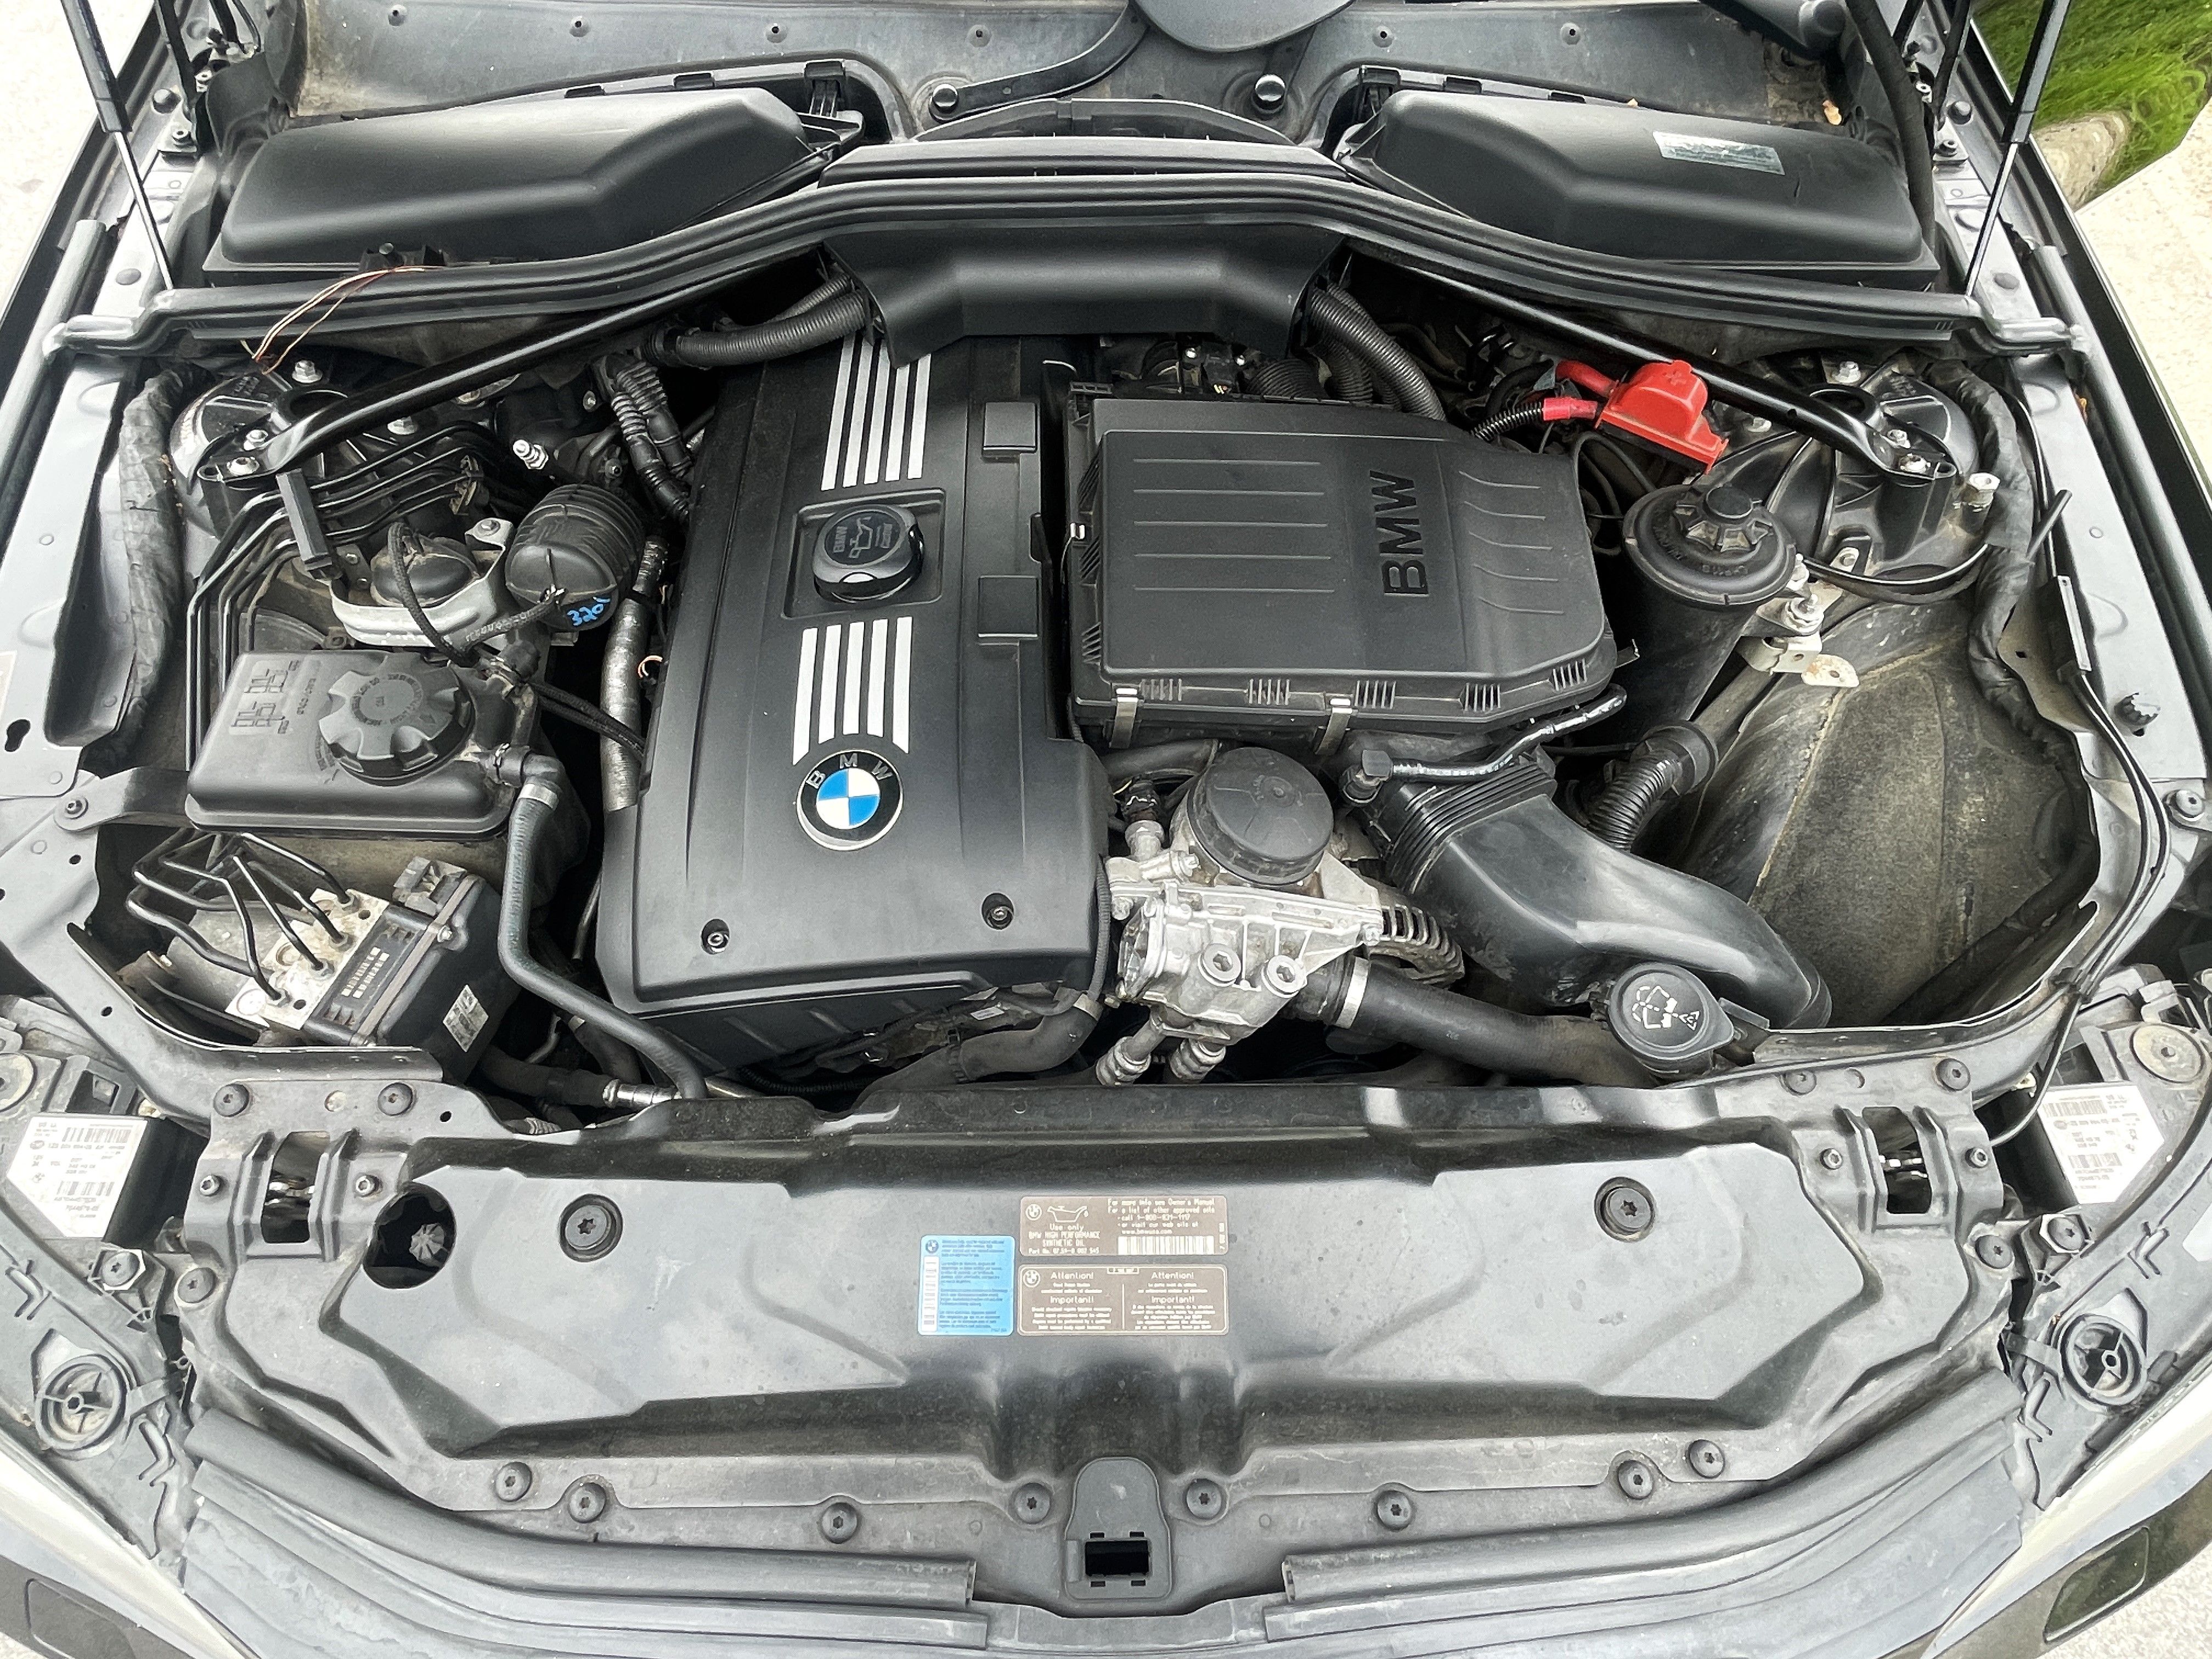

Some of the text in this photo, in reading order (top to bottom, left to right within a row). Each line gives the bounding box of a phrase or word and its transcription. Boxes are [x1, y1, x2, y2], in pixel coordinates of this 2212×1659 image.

[833, 526, 848, 554] BMW
[1369, 470, 1429, 596] BMW
[805, 753, 893, 789] BMW
[1049, 1223, 1084, 1232] Use only
[1050, 1295, 1094, 1305] Important!
[1151, 1295, 1195, 1305] Important!
